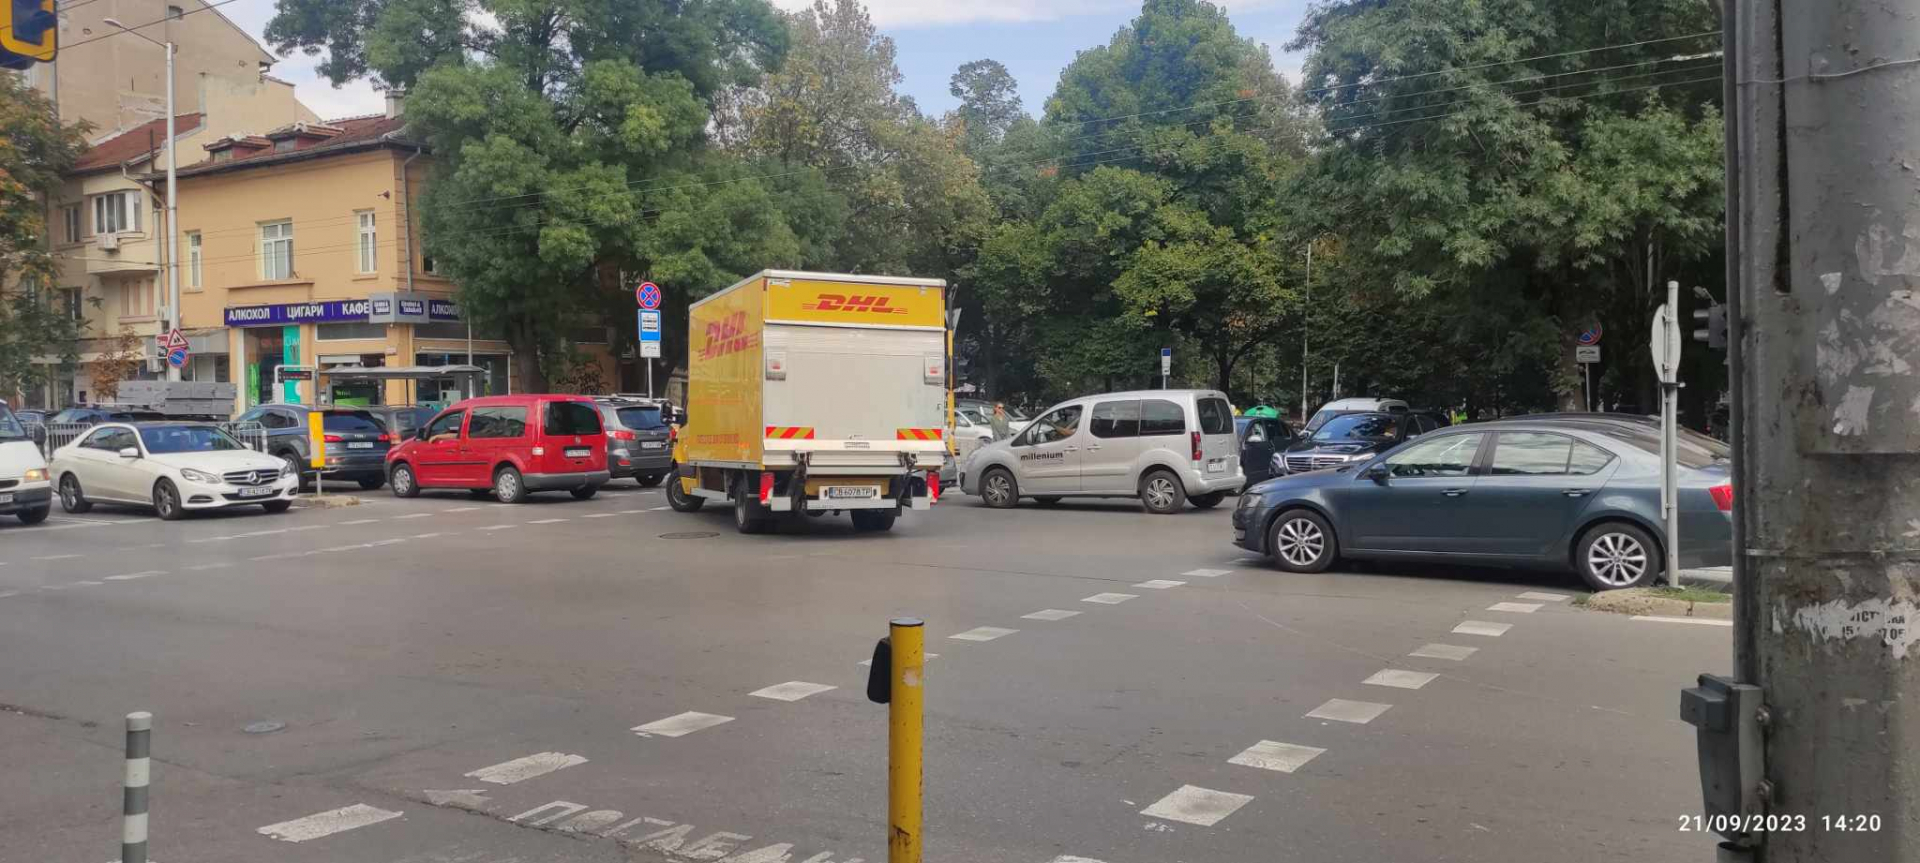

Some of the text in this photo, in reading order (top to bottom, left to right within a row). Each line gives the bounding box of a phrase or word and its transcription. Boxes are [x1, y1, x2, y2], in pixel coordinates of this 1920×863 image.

[228, 307, 270, 321] АЛКОХОЛ
[286, 304, 324, 319] ЦИГАРИ
[342, 302, 369, 316] КАФЕ
[816, 294, 894, 313] DHL
[704, 310, 750, 360] DHL
[1020, 450, 1063, 461] millenium
